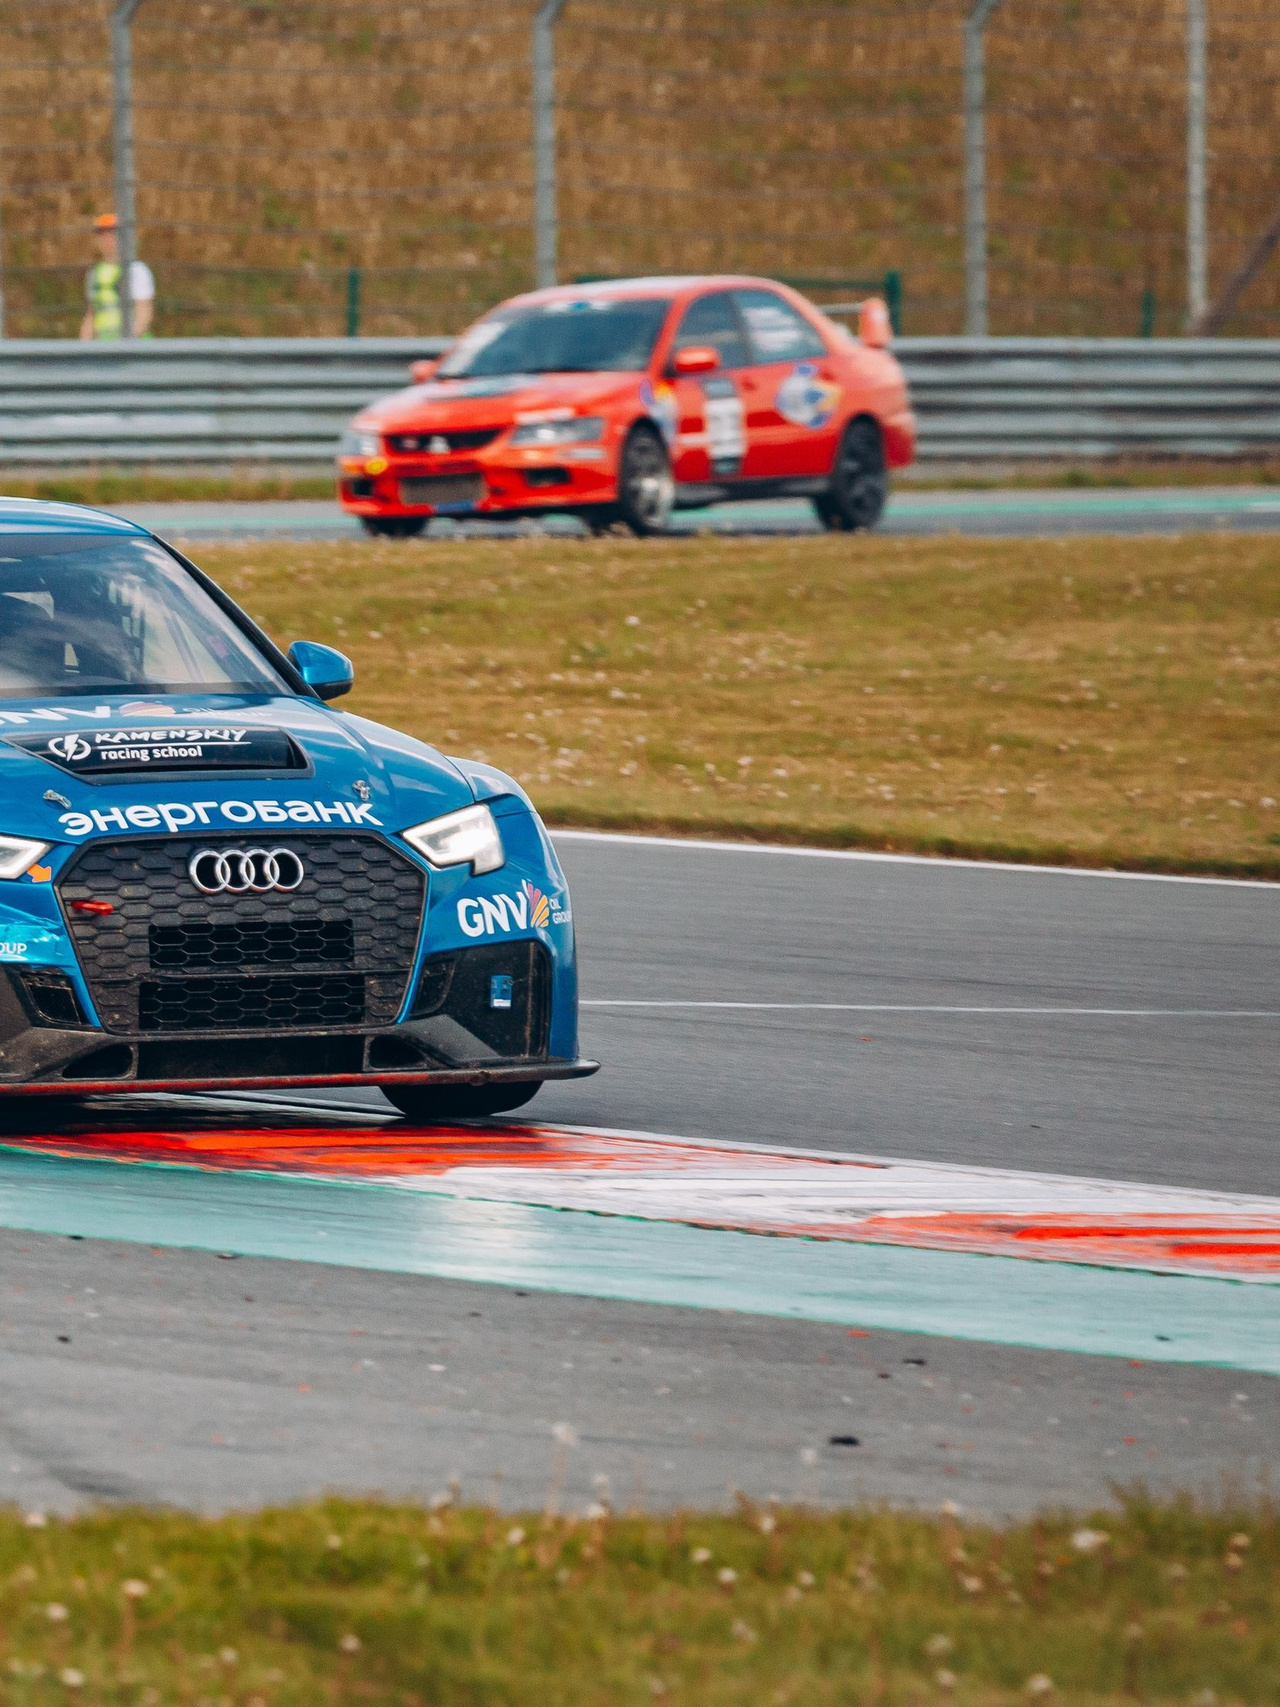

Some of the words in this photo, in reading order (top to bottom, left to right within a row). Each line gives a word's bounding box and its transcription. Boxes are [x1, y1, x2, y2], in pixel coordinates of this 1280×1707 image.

[95, 729, 248, 744] KAMENSKIY
[101, 748, 151, 762] racing
[152, 745, 202, 759] school
[457, 891, 528, 937] GNV
